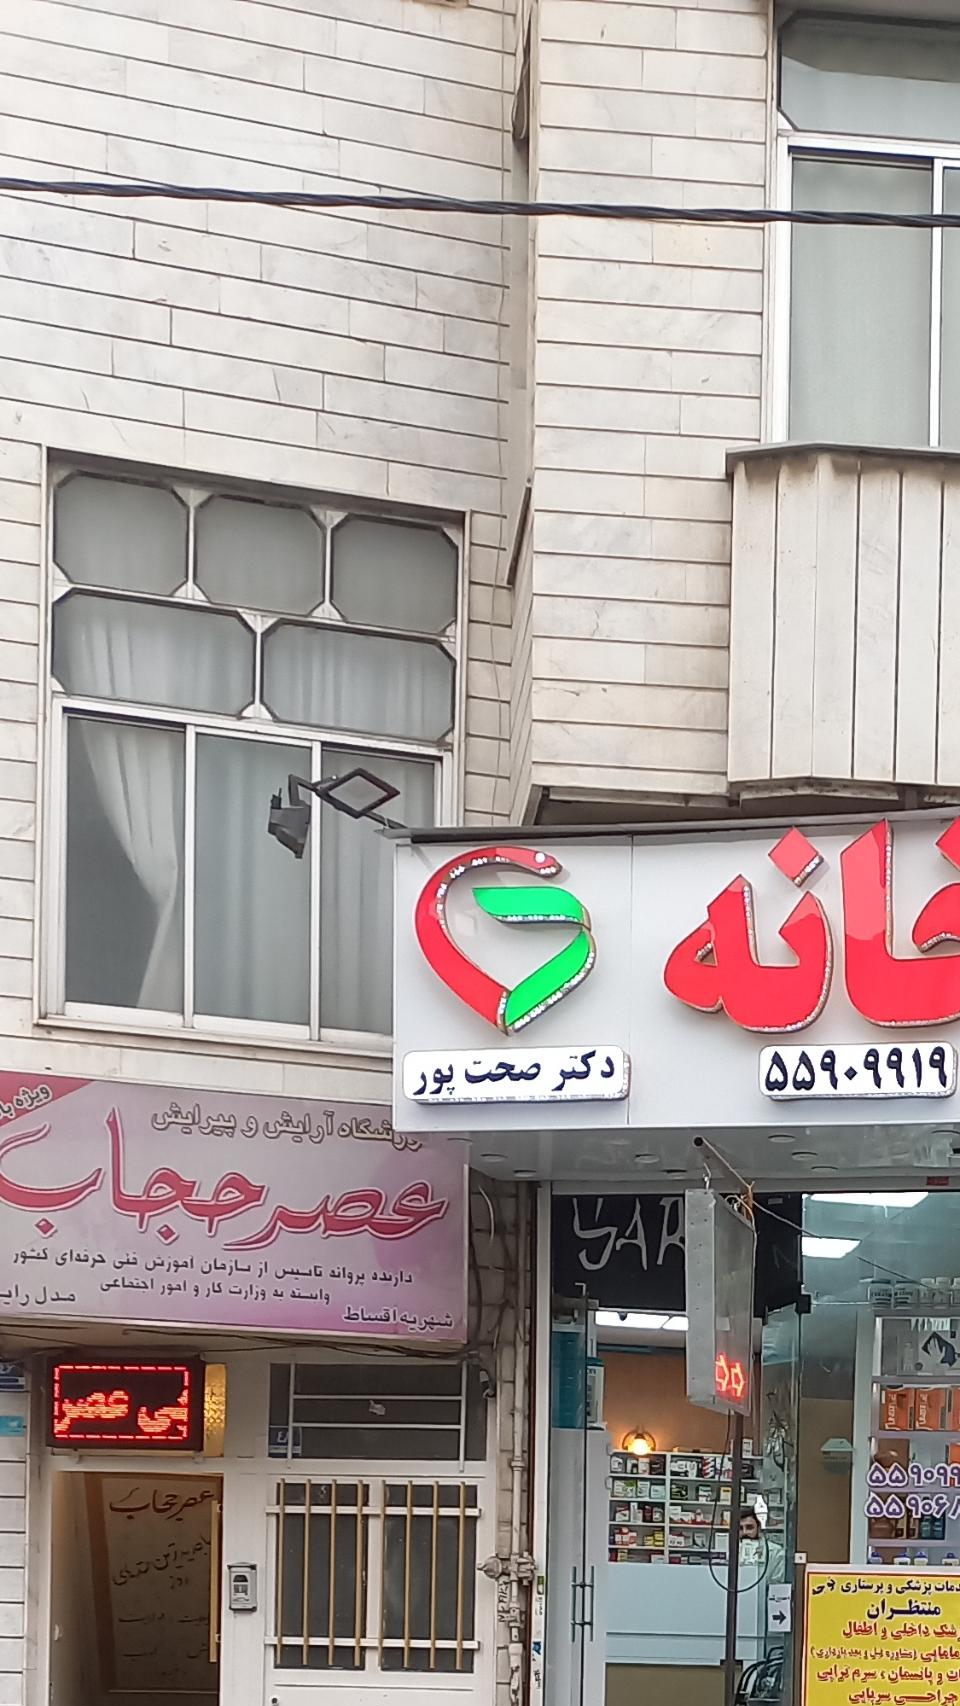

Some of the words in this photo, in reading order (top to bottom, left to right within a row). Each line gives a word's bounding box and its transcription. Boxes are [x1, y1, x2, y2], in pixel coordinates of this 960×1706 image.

[464, 1060, 542, 1085] صحت
[551, 1050, 616, 1092] دکتر
[763, 1045, 950, 1094] ۵۵۹۰۹۹۱۹
[412, 1063, 456, 1096] پور
[16, 1084, 51, 1107] ویژه
[152, 1102, 237, 1138] پیرایش
[241, 1115, 258, 1138] و
[264, 1110, 334, 1144] آرایش
[0, 1105, 269, 1246] حجاب
[222, 1181, 449, 1252] عصر
[13, 1247, 48, 1264] کشور
[112, 1250, 138, 1270] فنی
[200, 1257, 251, 1276] سازمان
[257, 1261, 268, 1279] از
[100, 1276, 154, 1294] اجتماعی
[329, 1266, 365, 1287] پروانه
[371, 1270, 412, 1288] دارنده
[35, 1285, 76, 1306] مدل
[160, 1279, 187, 1296] امور
[193, 1283, 201, 1297] و
[204, 1281, 222, 1298] کار
[228, 1283, 266, 1302] وزارت
[272, 1288, 284, 1302] به
[290, 1286, 331, 1305] وابسته
[343, 1305, 398, 1324] اقساط
[399, 1311, 454, 1332] شهریه
[841, 1578, 883, 1596] پرستاری
[886, 1583, 893, 1594] و
[896, 1579, 931, 1596] پزشکی
[867, 1598, 941, 1620] منتظران
[842, 1620, 878, 1638] اطفال
[881, 1629, 888, 1641] و
[891, 1622, 931, 1641] داخلی
[920, 1645, 960, 1662] مامایی
[817, 1664, 850, 1682] تراپی
[852, 1668, 878, 1683] سرم
[936, 1673, 943, 1684] و
[849, 1687, 892, 1706] سرپایی
